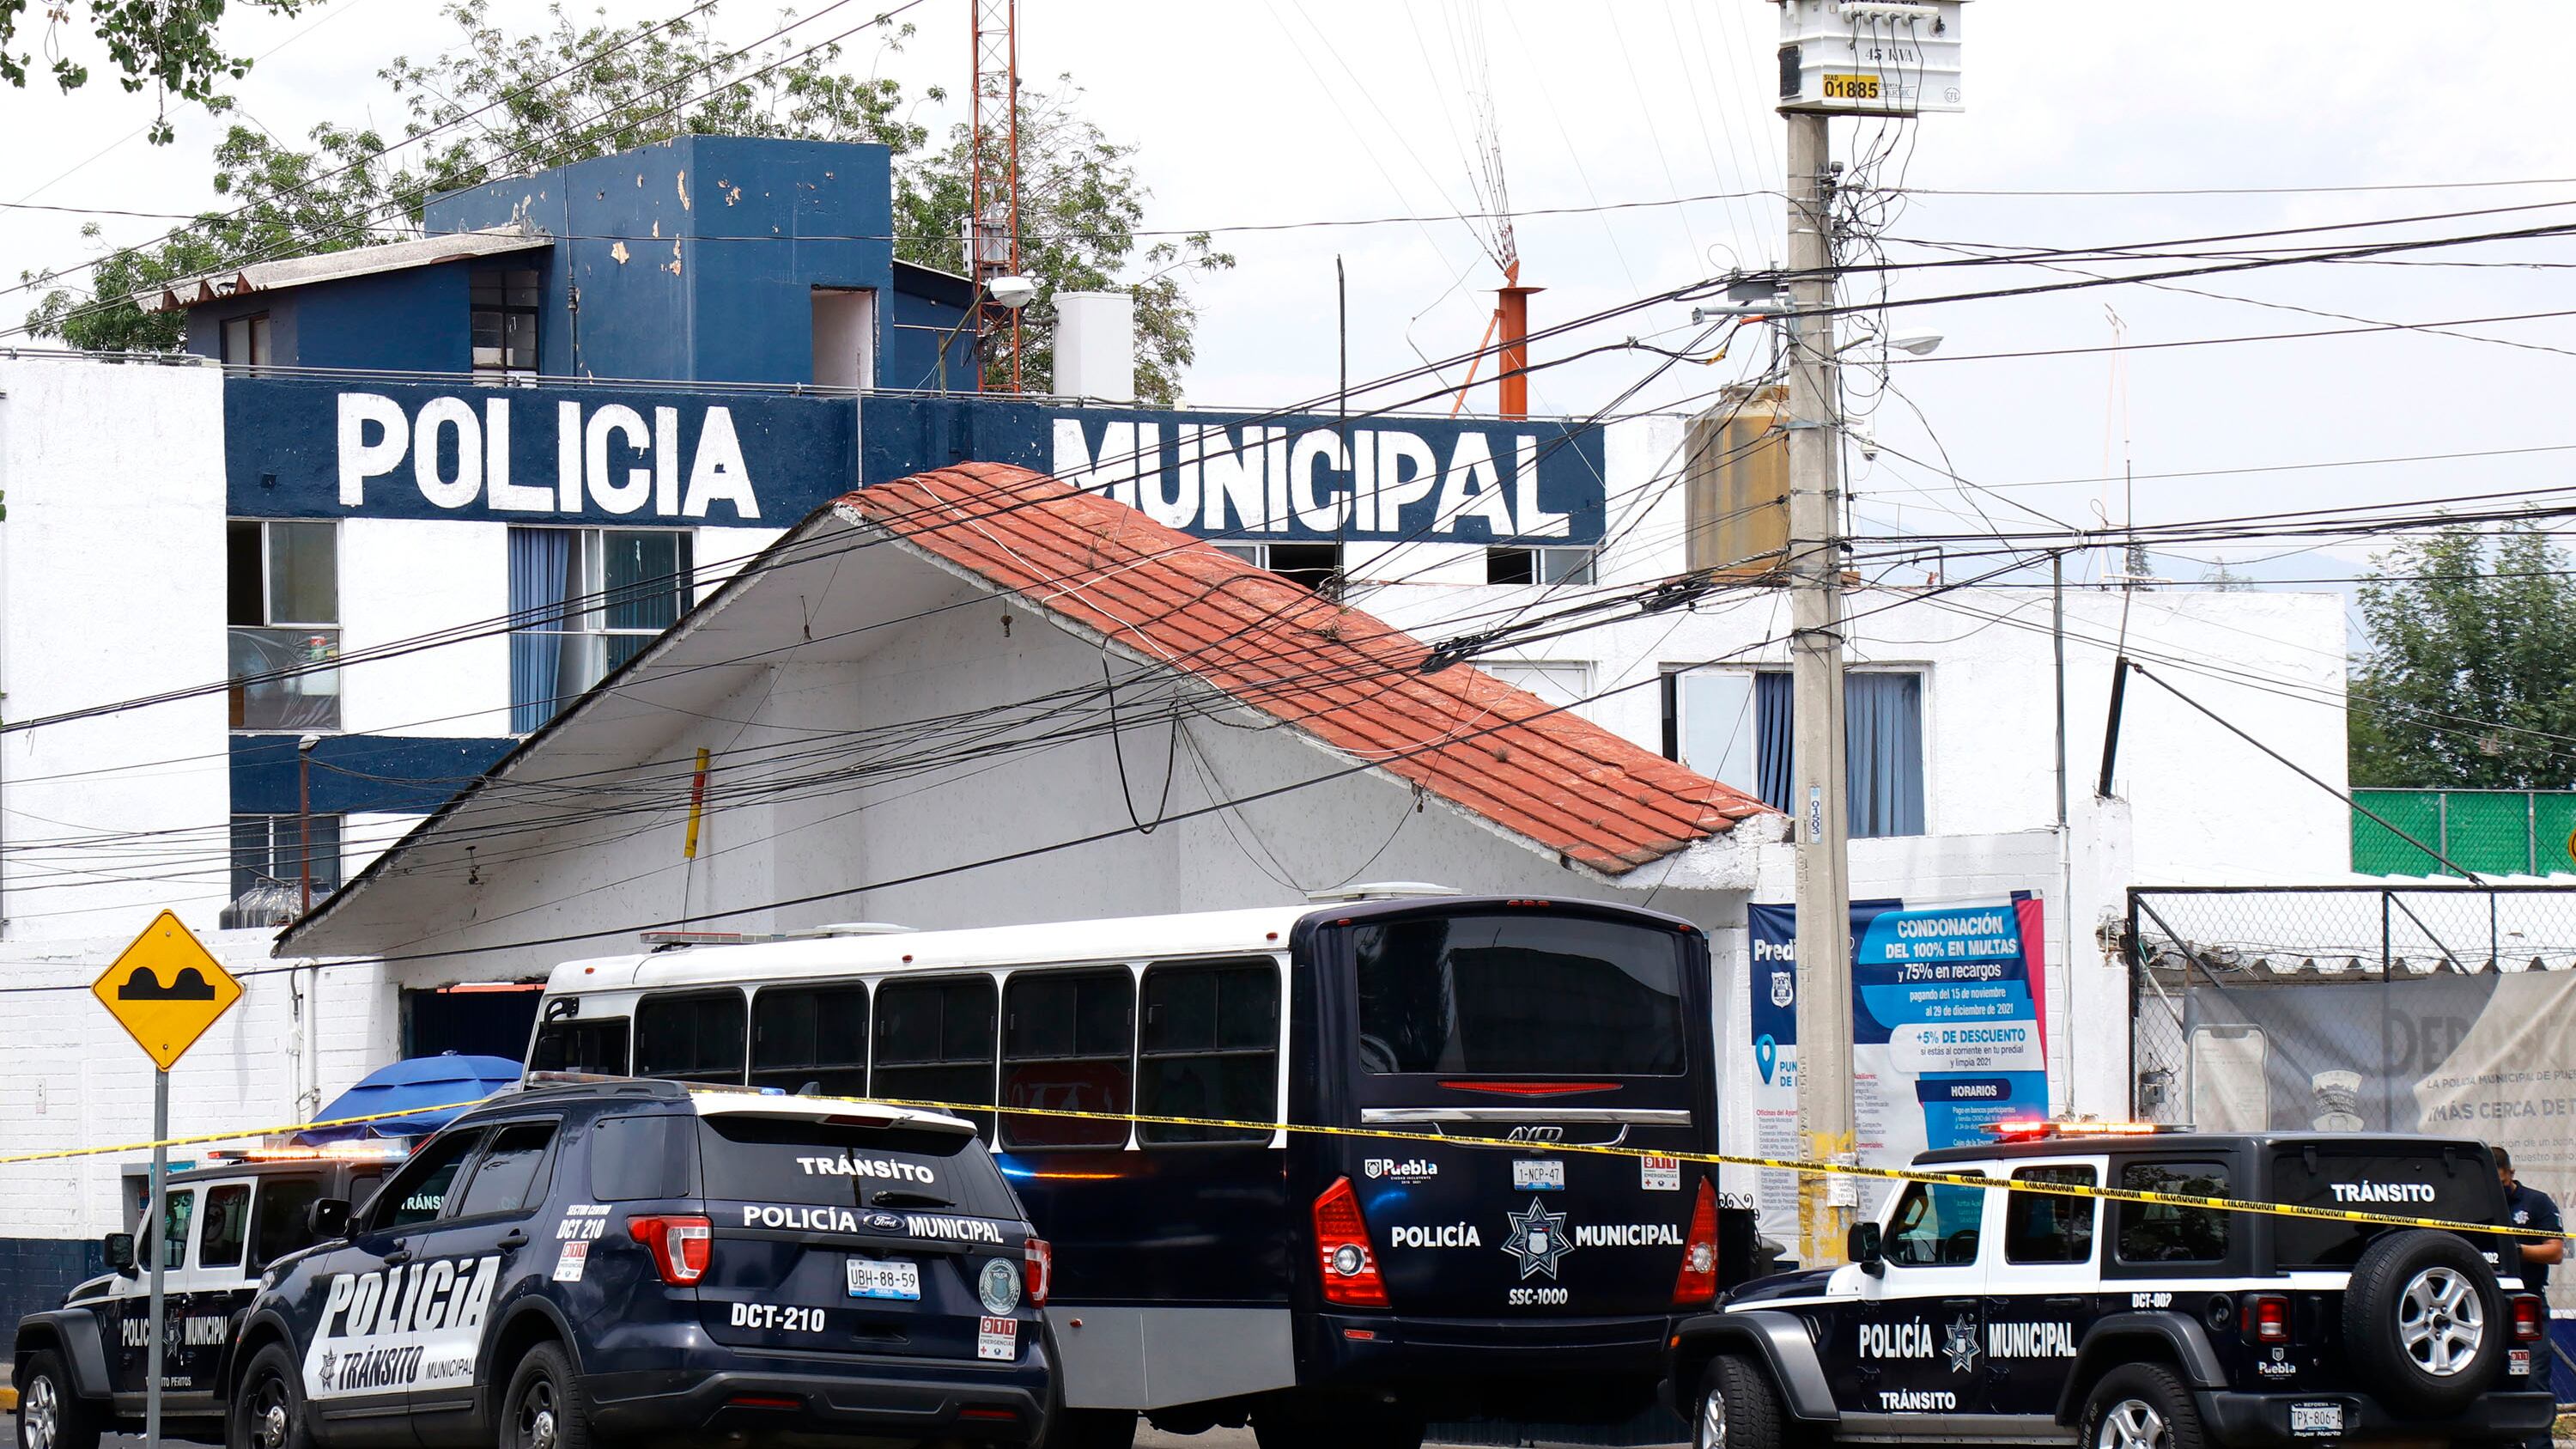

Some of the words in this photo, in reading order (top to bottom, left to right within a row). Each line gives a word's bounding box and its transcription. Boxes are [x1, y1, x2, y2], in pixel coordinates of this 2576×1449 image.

[1825, 81, 1879, 99] 01885
[337, 392, 761, 520] POLICIA
[1053, 418, 1571, 538] MUNICIPAL
[1897, 913, 2003, 939] CONDONACIÓN
[1886, 943, 1910, 959] DEL
[1913, 941, 1945, 958] 100%
[1947, 941, 1965, 957] EN
[1968, 938, 2018, 955] MULTAS
[1898, 971, 1904, 983] y
[1905, 963, 1933, 980] 75%
[1935, 967, 1950, 978] en
[1952, 964, 2002, 981] recargos
[1910, 989, 1939, 1002] pagando
[1939, 989, 1950, 1000] del
[1951, 988, 1959, 1000] 15
[1961, 989, 1971, 1000] de
[1971, 986, 2007, 999] noviembre
[1926, 1006, 1932, 1017] al
[1933, 1006, 1942, 1017] 29
[1943, 1005, 1952, 1016] de
[1953, 1003, 1986, 1016] diciembre
[1987, 1003, 1996, 1015] de
[1996, 1002, 2014, 1014] 2021
[1917, 1030, 1939, 1044] +5%
[1942, 1030, 1957, 1044] DE
[1960, 1028, 2026, 1043] DESCUENTO
[1946, 1045, 1952, 1055] al
[1953, 1045, 1982, 1055] corriente
[1984, 1046, 1992, 1055] en
[1993, 1045, 2000, 1055] tu
[2001, 1044, 2024, 1056] predial
[1950, 1060, 1954, 1068] y
[1955, 1058, 1975, 1068] limpia
[1977, 1057, 1991, 1067] 2021
[1780, 1076, 1792, 1087] DE
[2537, 1070, 2551, 1081] DE
[1951, 1085, 1997, 1097] HORARIOS
[2479, 1099, 2537, 1119] CERCA
[2543, 1098, 2566, 1116] DE
[1382, 1159, 1438, 1176] Puebla
[1645, 1157, 1674, 1168] 911
[1519, 1168, 1559, 1181] 1-NCP-47
[2330, 1180, 2436, 1202] TRÁNSITO
[567, 1205, 590, 1215] SECTOR
[556, 1219, 583, 1239] DCT
[580, 1219, 606, 1239] 210
[743, 1205, 858, 1233] POLICÍA
[873, 1215, 897, 1227] Ford
[907, 1215, 1004, 1244] MUNICIPAL
[1391, 1221, 1481, 1248] POLICÍA
[1576, 1224, 1684, 1247] MUNICIPAL
[563, 1244, 586, 1258] 911
[850, 1269, 916, 1288] UBH-88-59
[317, 1256, 501, 1338] POLICÍA
[1508, 1288, 1569, 1306] SSC-1000
[731, 1302, 825, 1332] DCT-210
[123, 1318, 149, 1347] POLIC
[983, 1320, 1014, 1334] 911
[980, 1338, 1015, 1347] EMERGENCIAS
[1859, 1316, 1935, 1359] POLICÍA
[1989, 1322, 2077, 1358] MUNICIPAL
[338, 1344, 424, 1391] TRÁNSITO
[426, 1358, 473, 1380] MUNICIPAL
[2258, 1361, 2297, 1375] Puebla
[171, 1376, 191, 1387] PERITOS
[1880, 1388, 1957, 1409] TRÁNSITO
